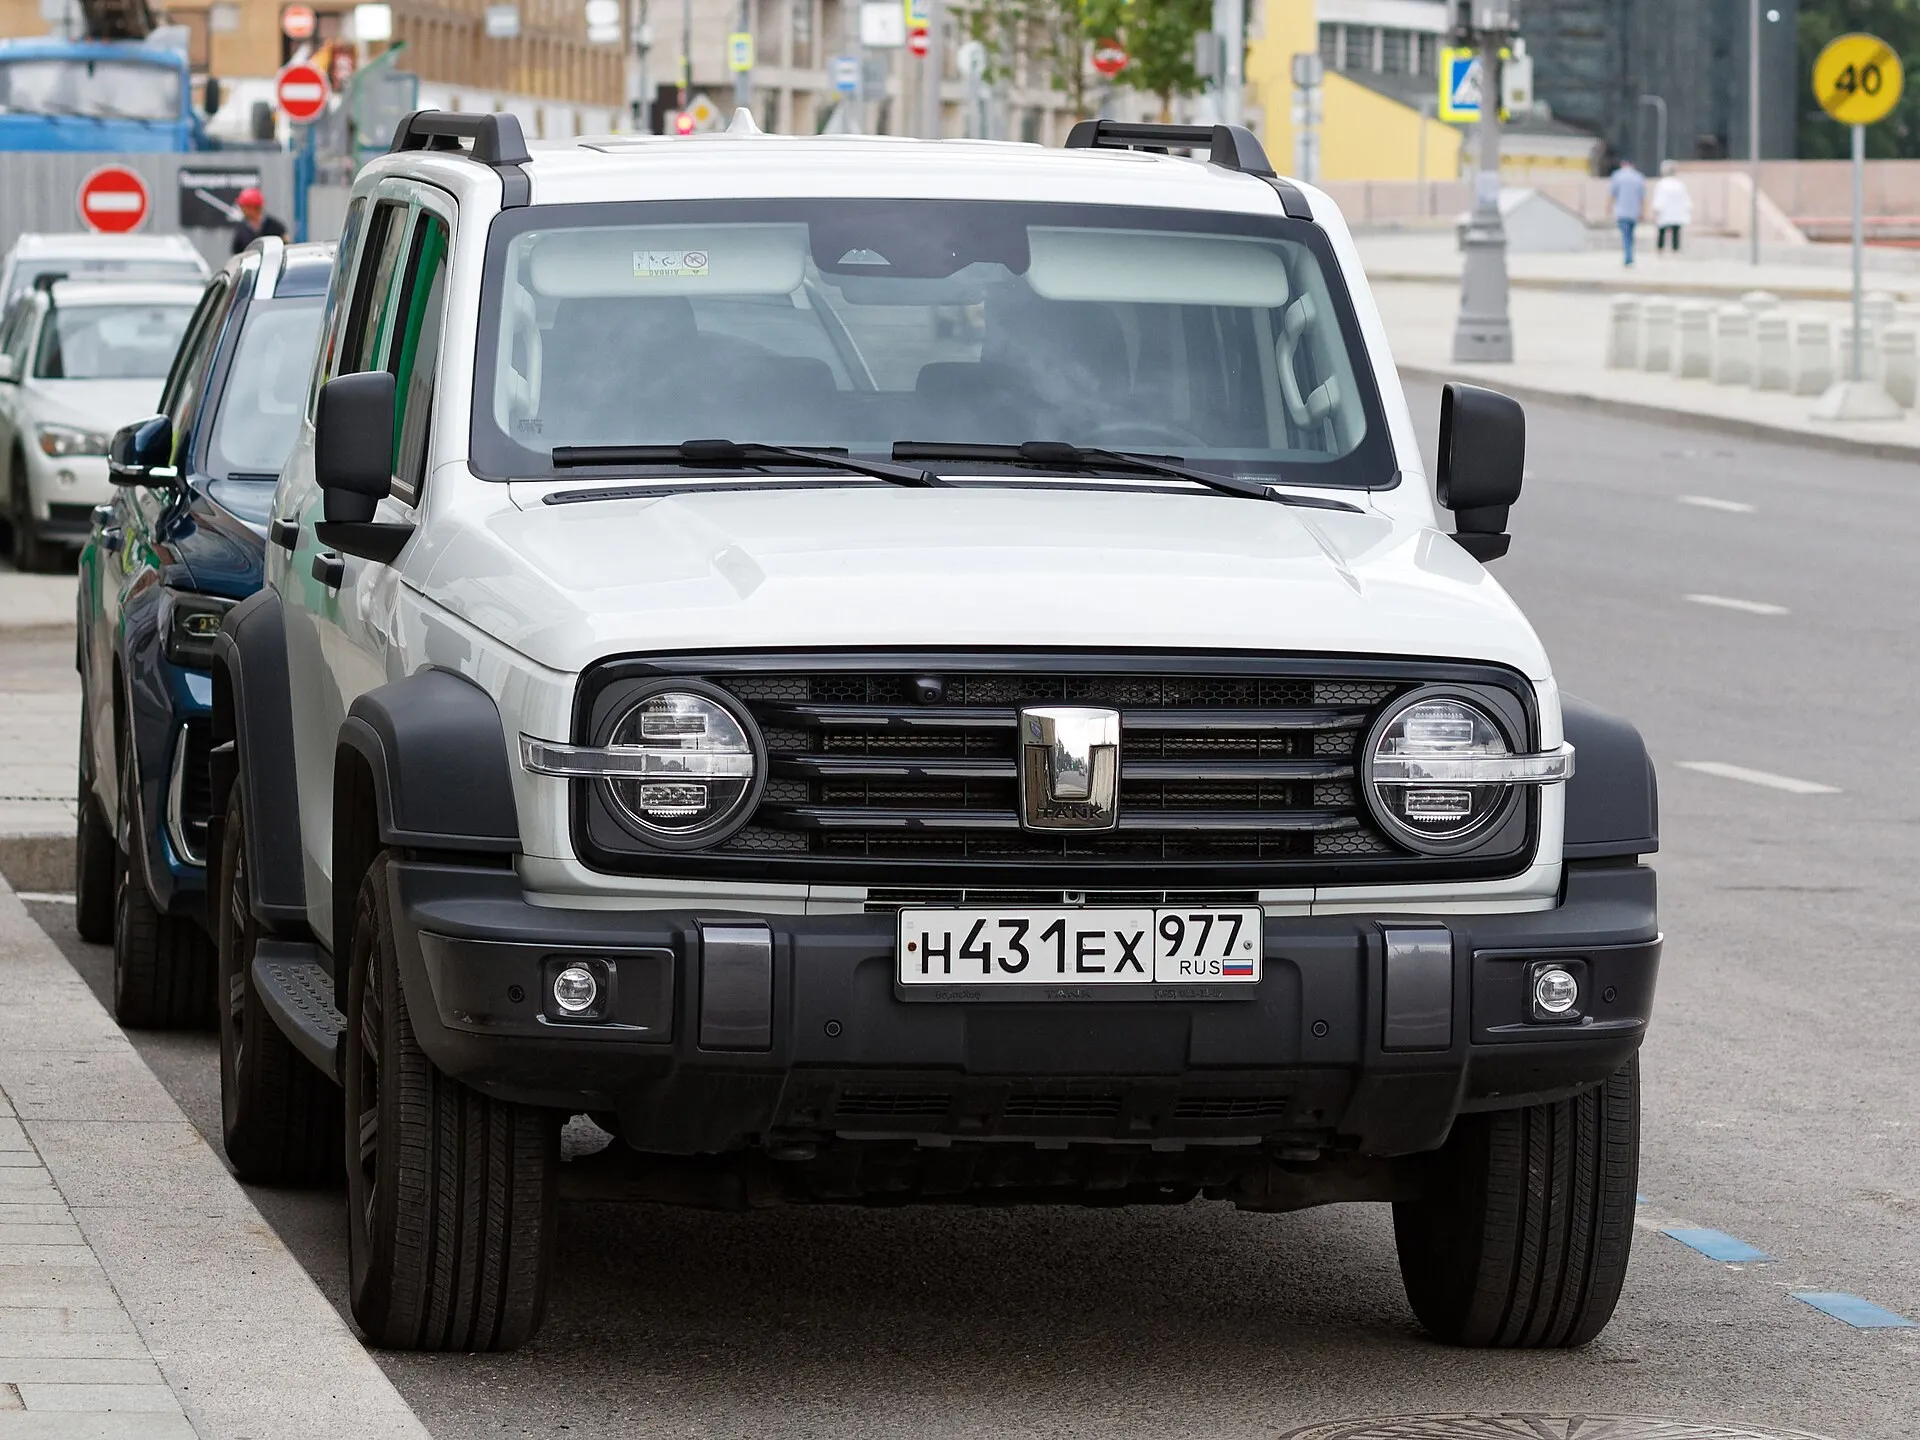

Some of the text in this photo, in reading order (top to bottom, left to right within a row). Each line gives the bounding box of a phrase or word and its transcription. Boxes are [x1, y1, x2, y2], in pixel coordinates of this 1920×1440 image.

[1834, 62, 1882, 97] 40
[1036, 806, 1103, 819] TANK
[1159, 914, 1243, 957] 977
[1180, 960, 1220, 975] RUS
